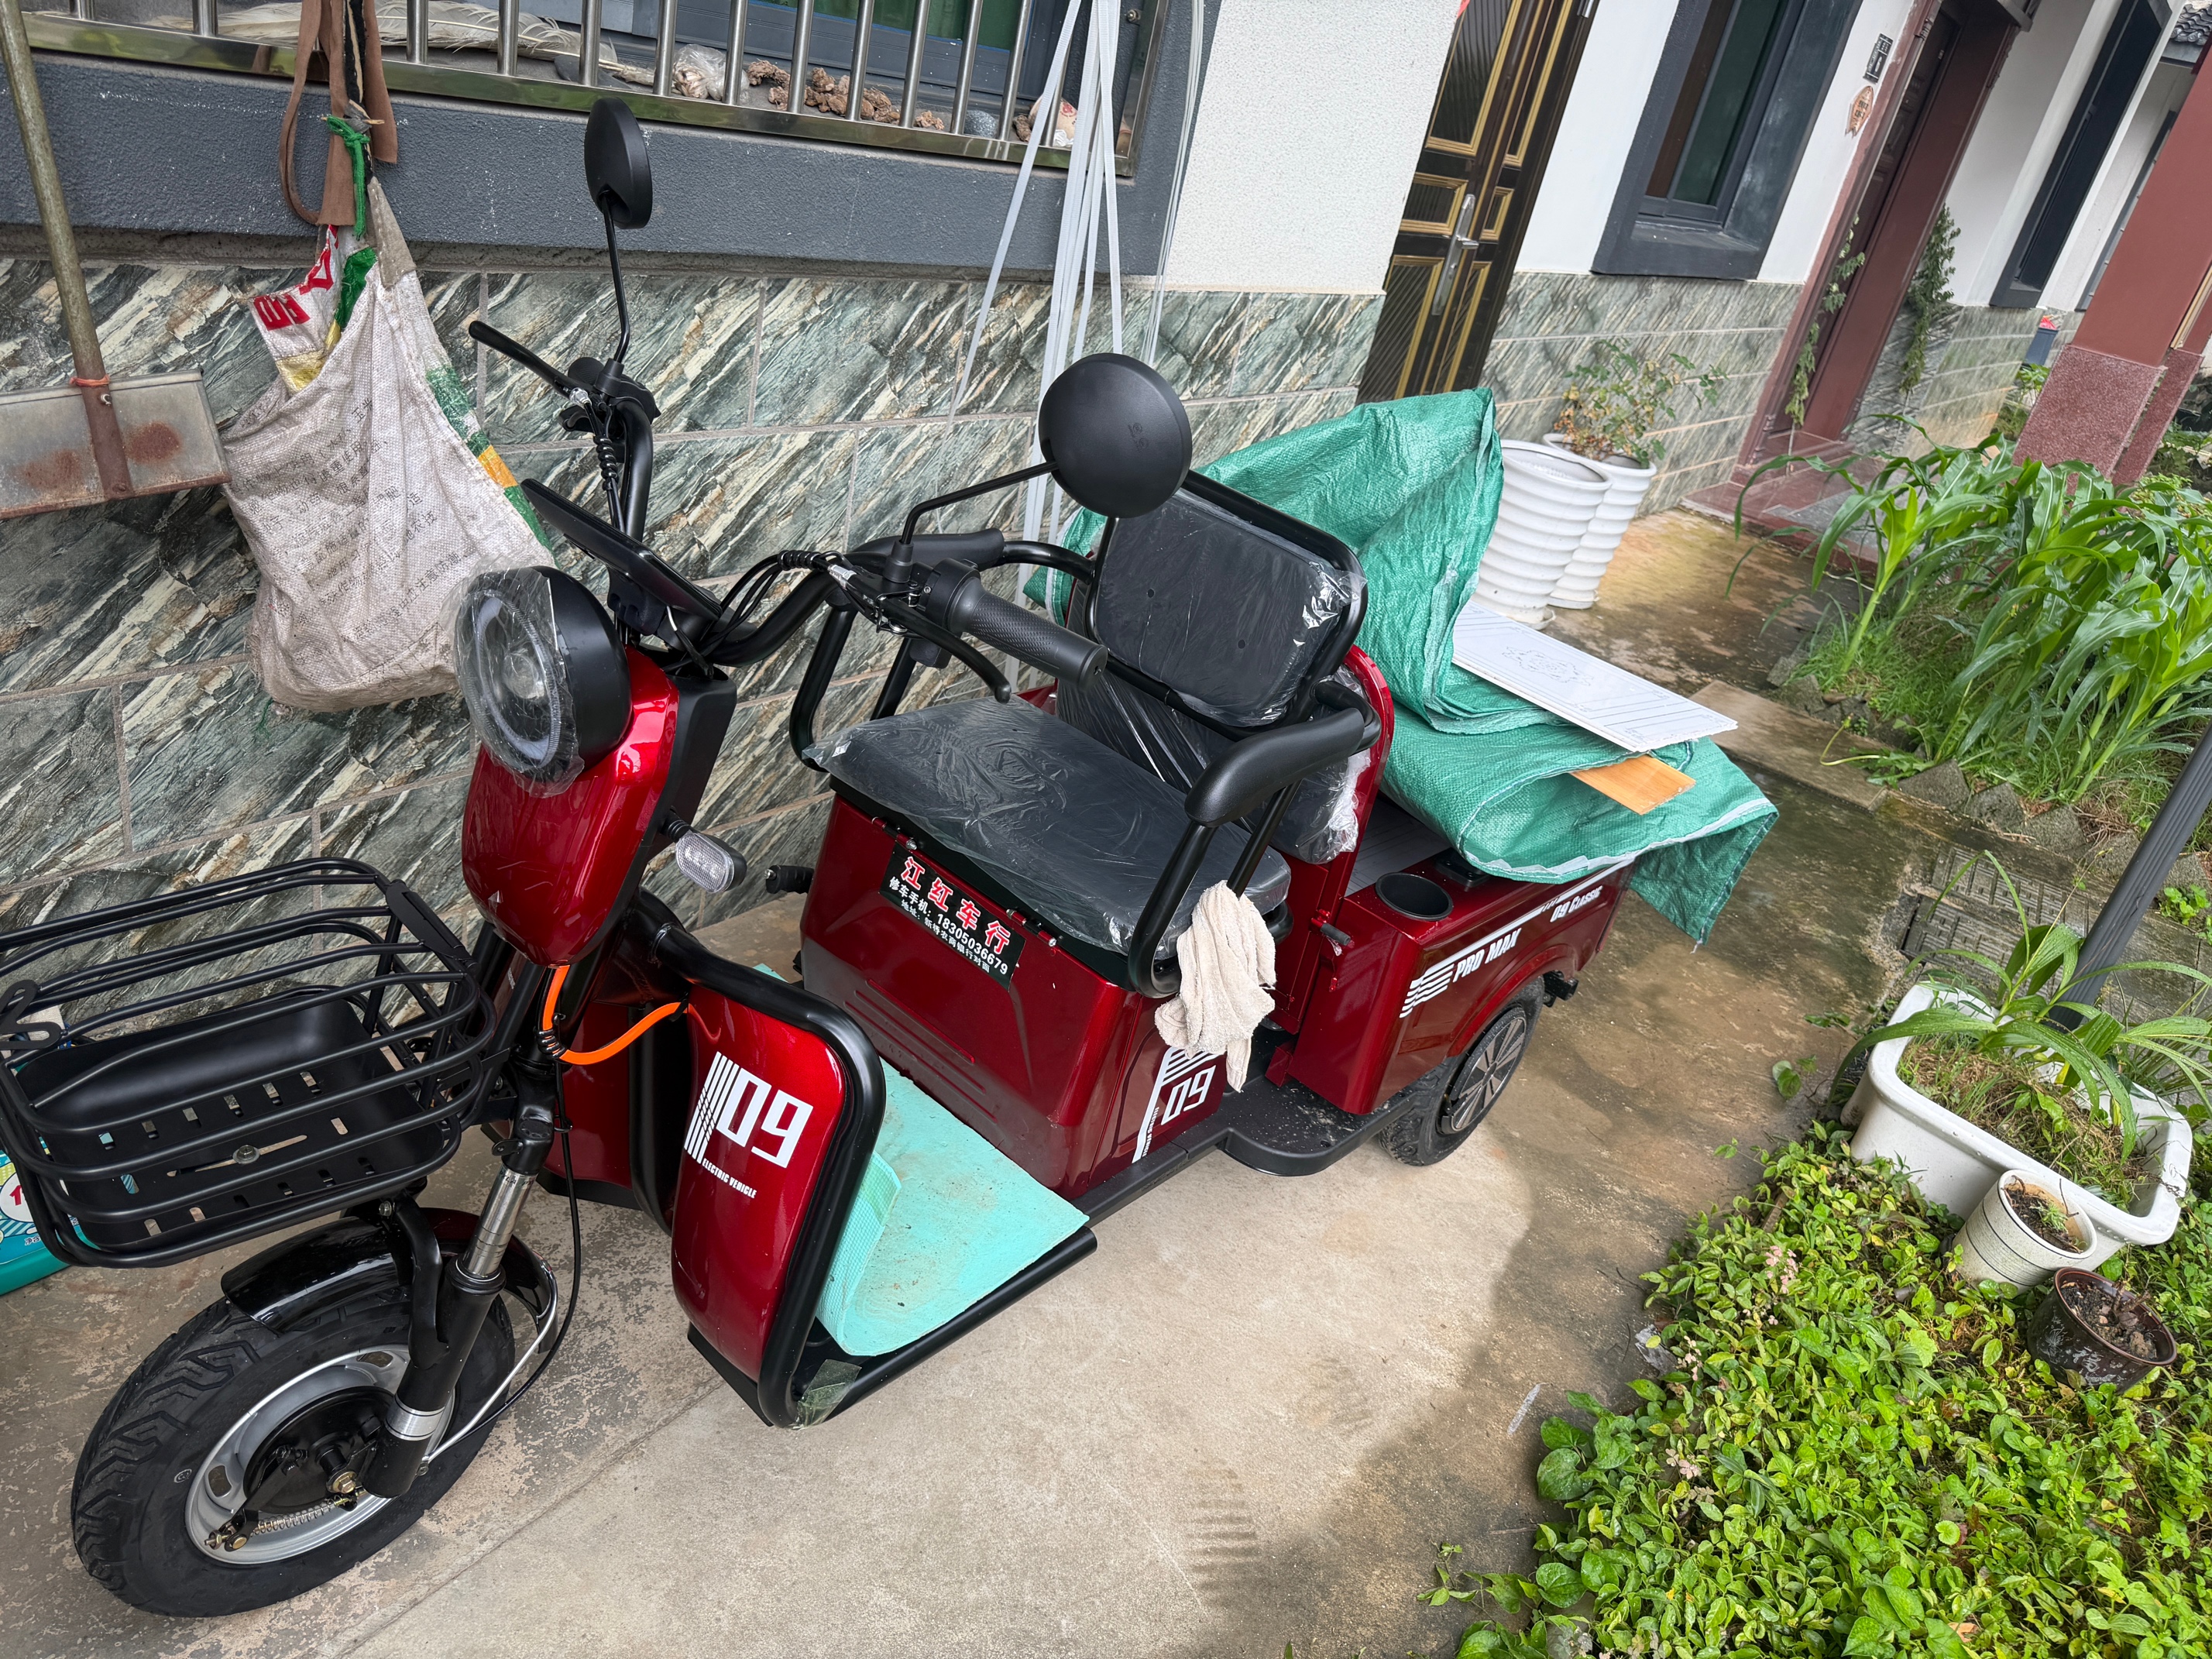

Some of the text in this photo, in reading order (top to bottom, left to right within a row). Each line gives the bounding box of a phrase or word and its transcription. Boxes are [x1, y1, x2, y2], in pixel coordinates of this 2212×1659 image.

[901, 856, 1011, 955] 江红车行
[1550, 901, 1571, 922] 09
[1452, 949, 1485, 983] PRO
[716, 1067, 813, 1169] 09
[1160, 1065, 1216, 1125] 09
[702, 1158, 757, 1199] ELECTRIC VEHICLE
